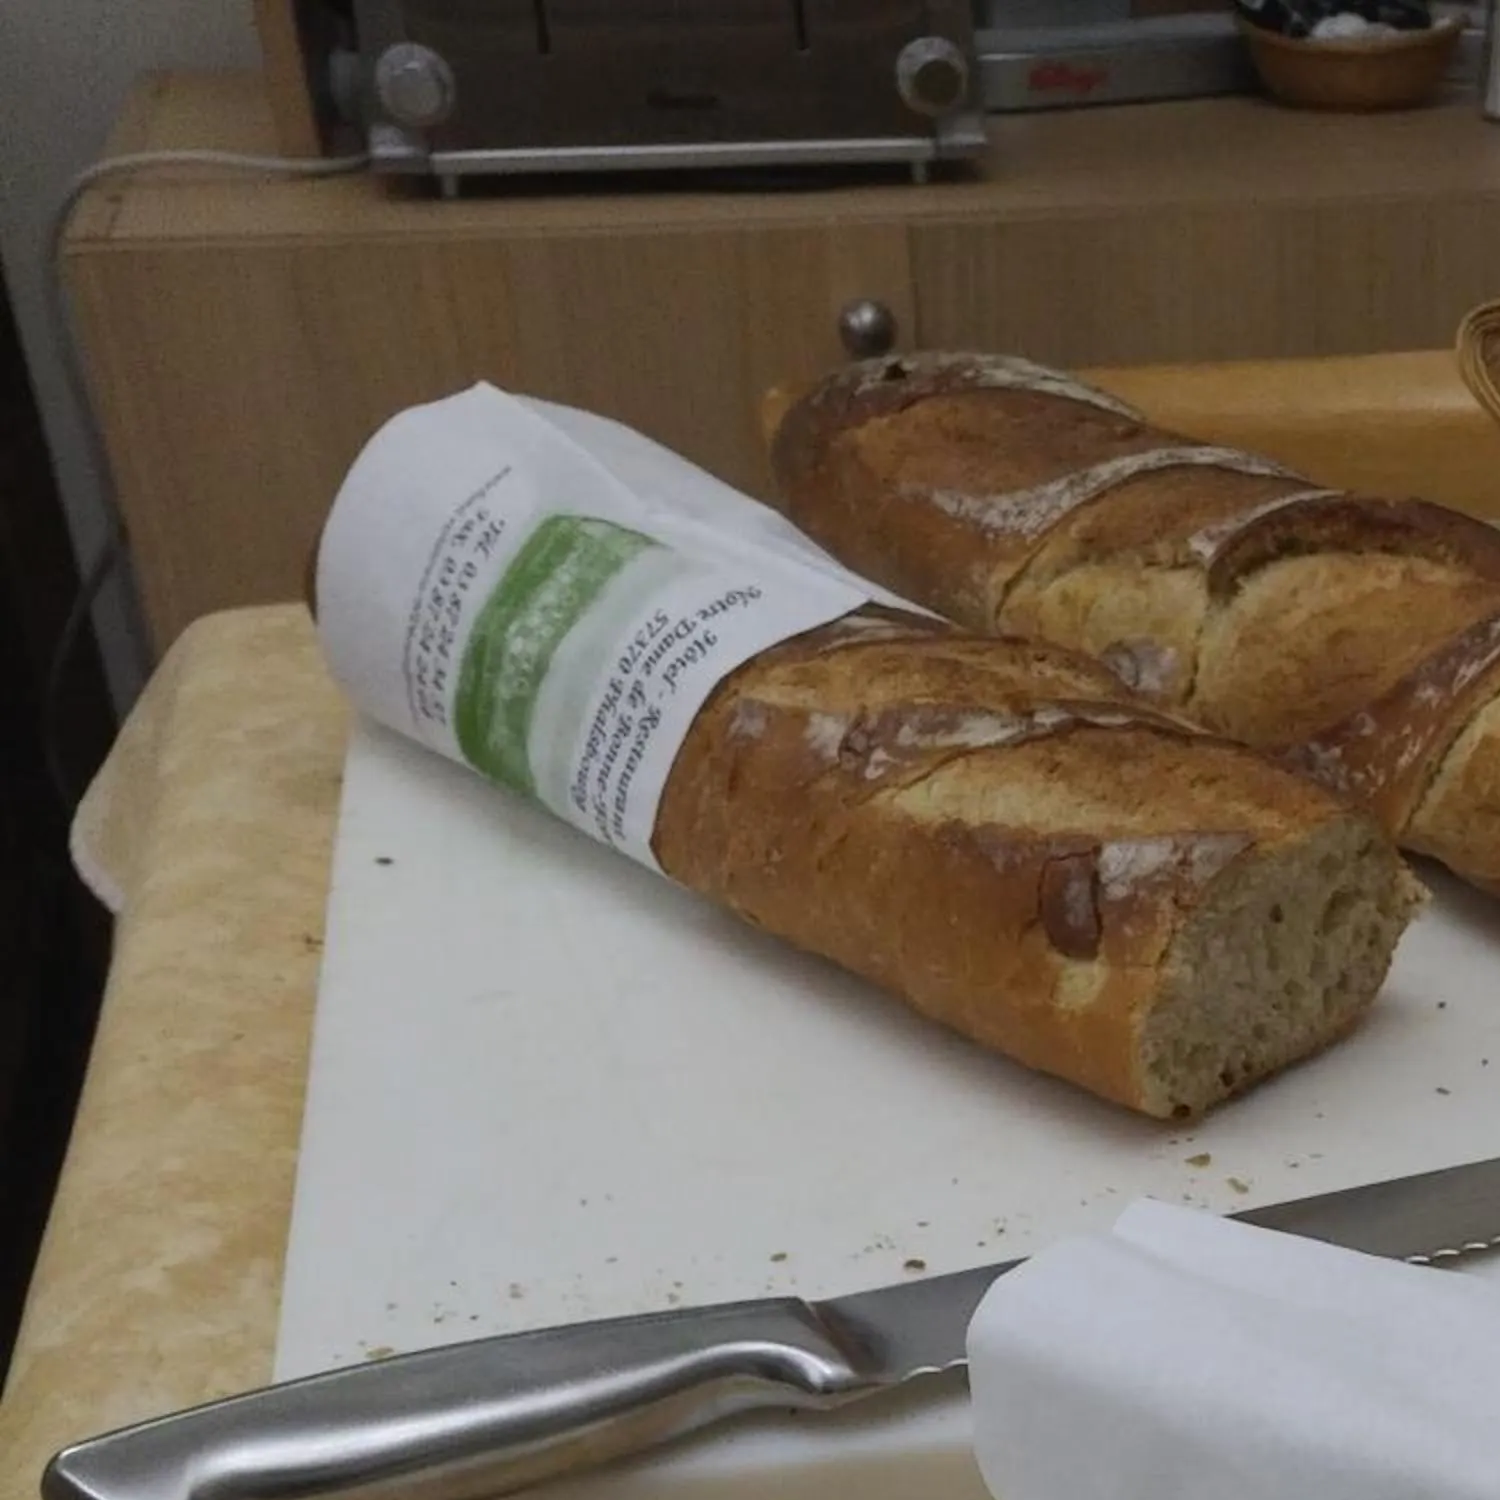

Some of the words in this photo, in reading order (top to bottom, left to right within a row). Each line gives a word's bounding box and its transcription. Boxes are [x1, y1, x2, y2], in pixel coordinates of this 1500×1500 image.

[699, 585, 762, 622] Notre
[618, 607, 670, 676] 57370
[641, 618, 697, 675] Dame
[629, 680, 647, 709] de
[613, 705, 661, 841] Restaurant
